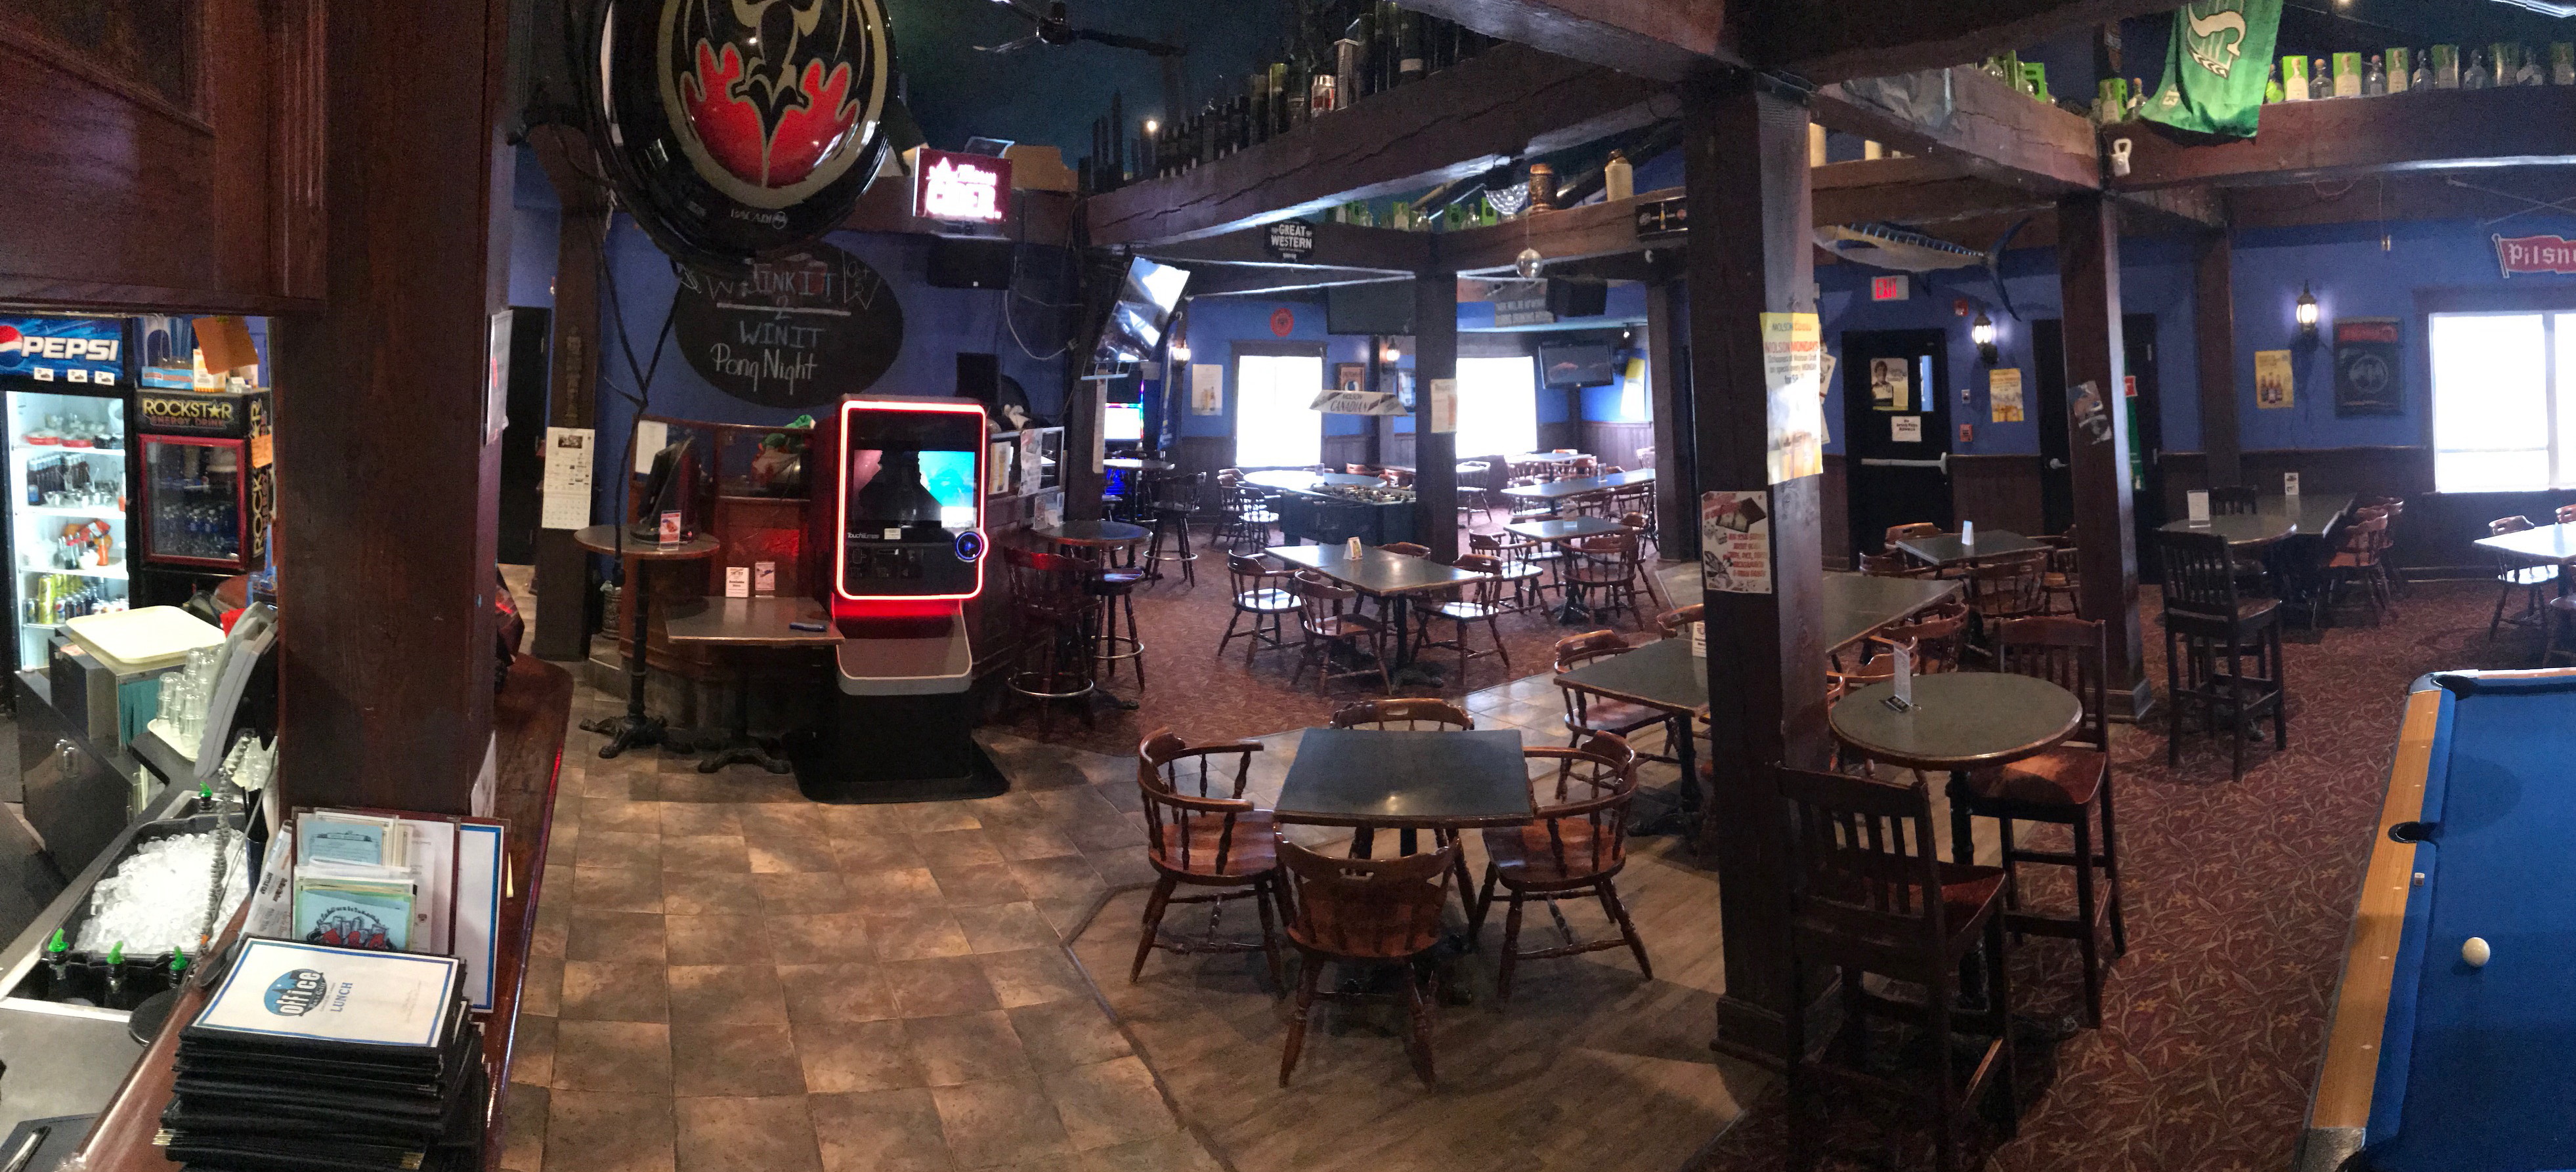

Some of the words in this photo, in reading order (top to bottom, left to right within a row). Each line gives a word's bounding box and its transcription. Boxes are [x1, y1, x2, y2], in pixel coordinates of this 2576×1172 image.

[1279, 224, 1306, 236] GREAT
[1271, 234, 1312, 249] WESTERN
[21, 335, 119, 362] PEPSI
[710, 343, 760, 393] Pong
[763, 348, 819, 396] Night
[194, 418, 224, 427] DRINK
[330, 982, 354, 1013] LUNCH
